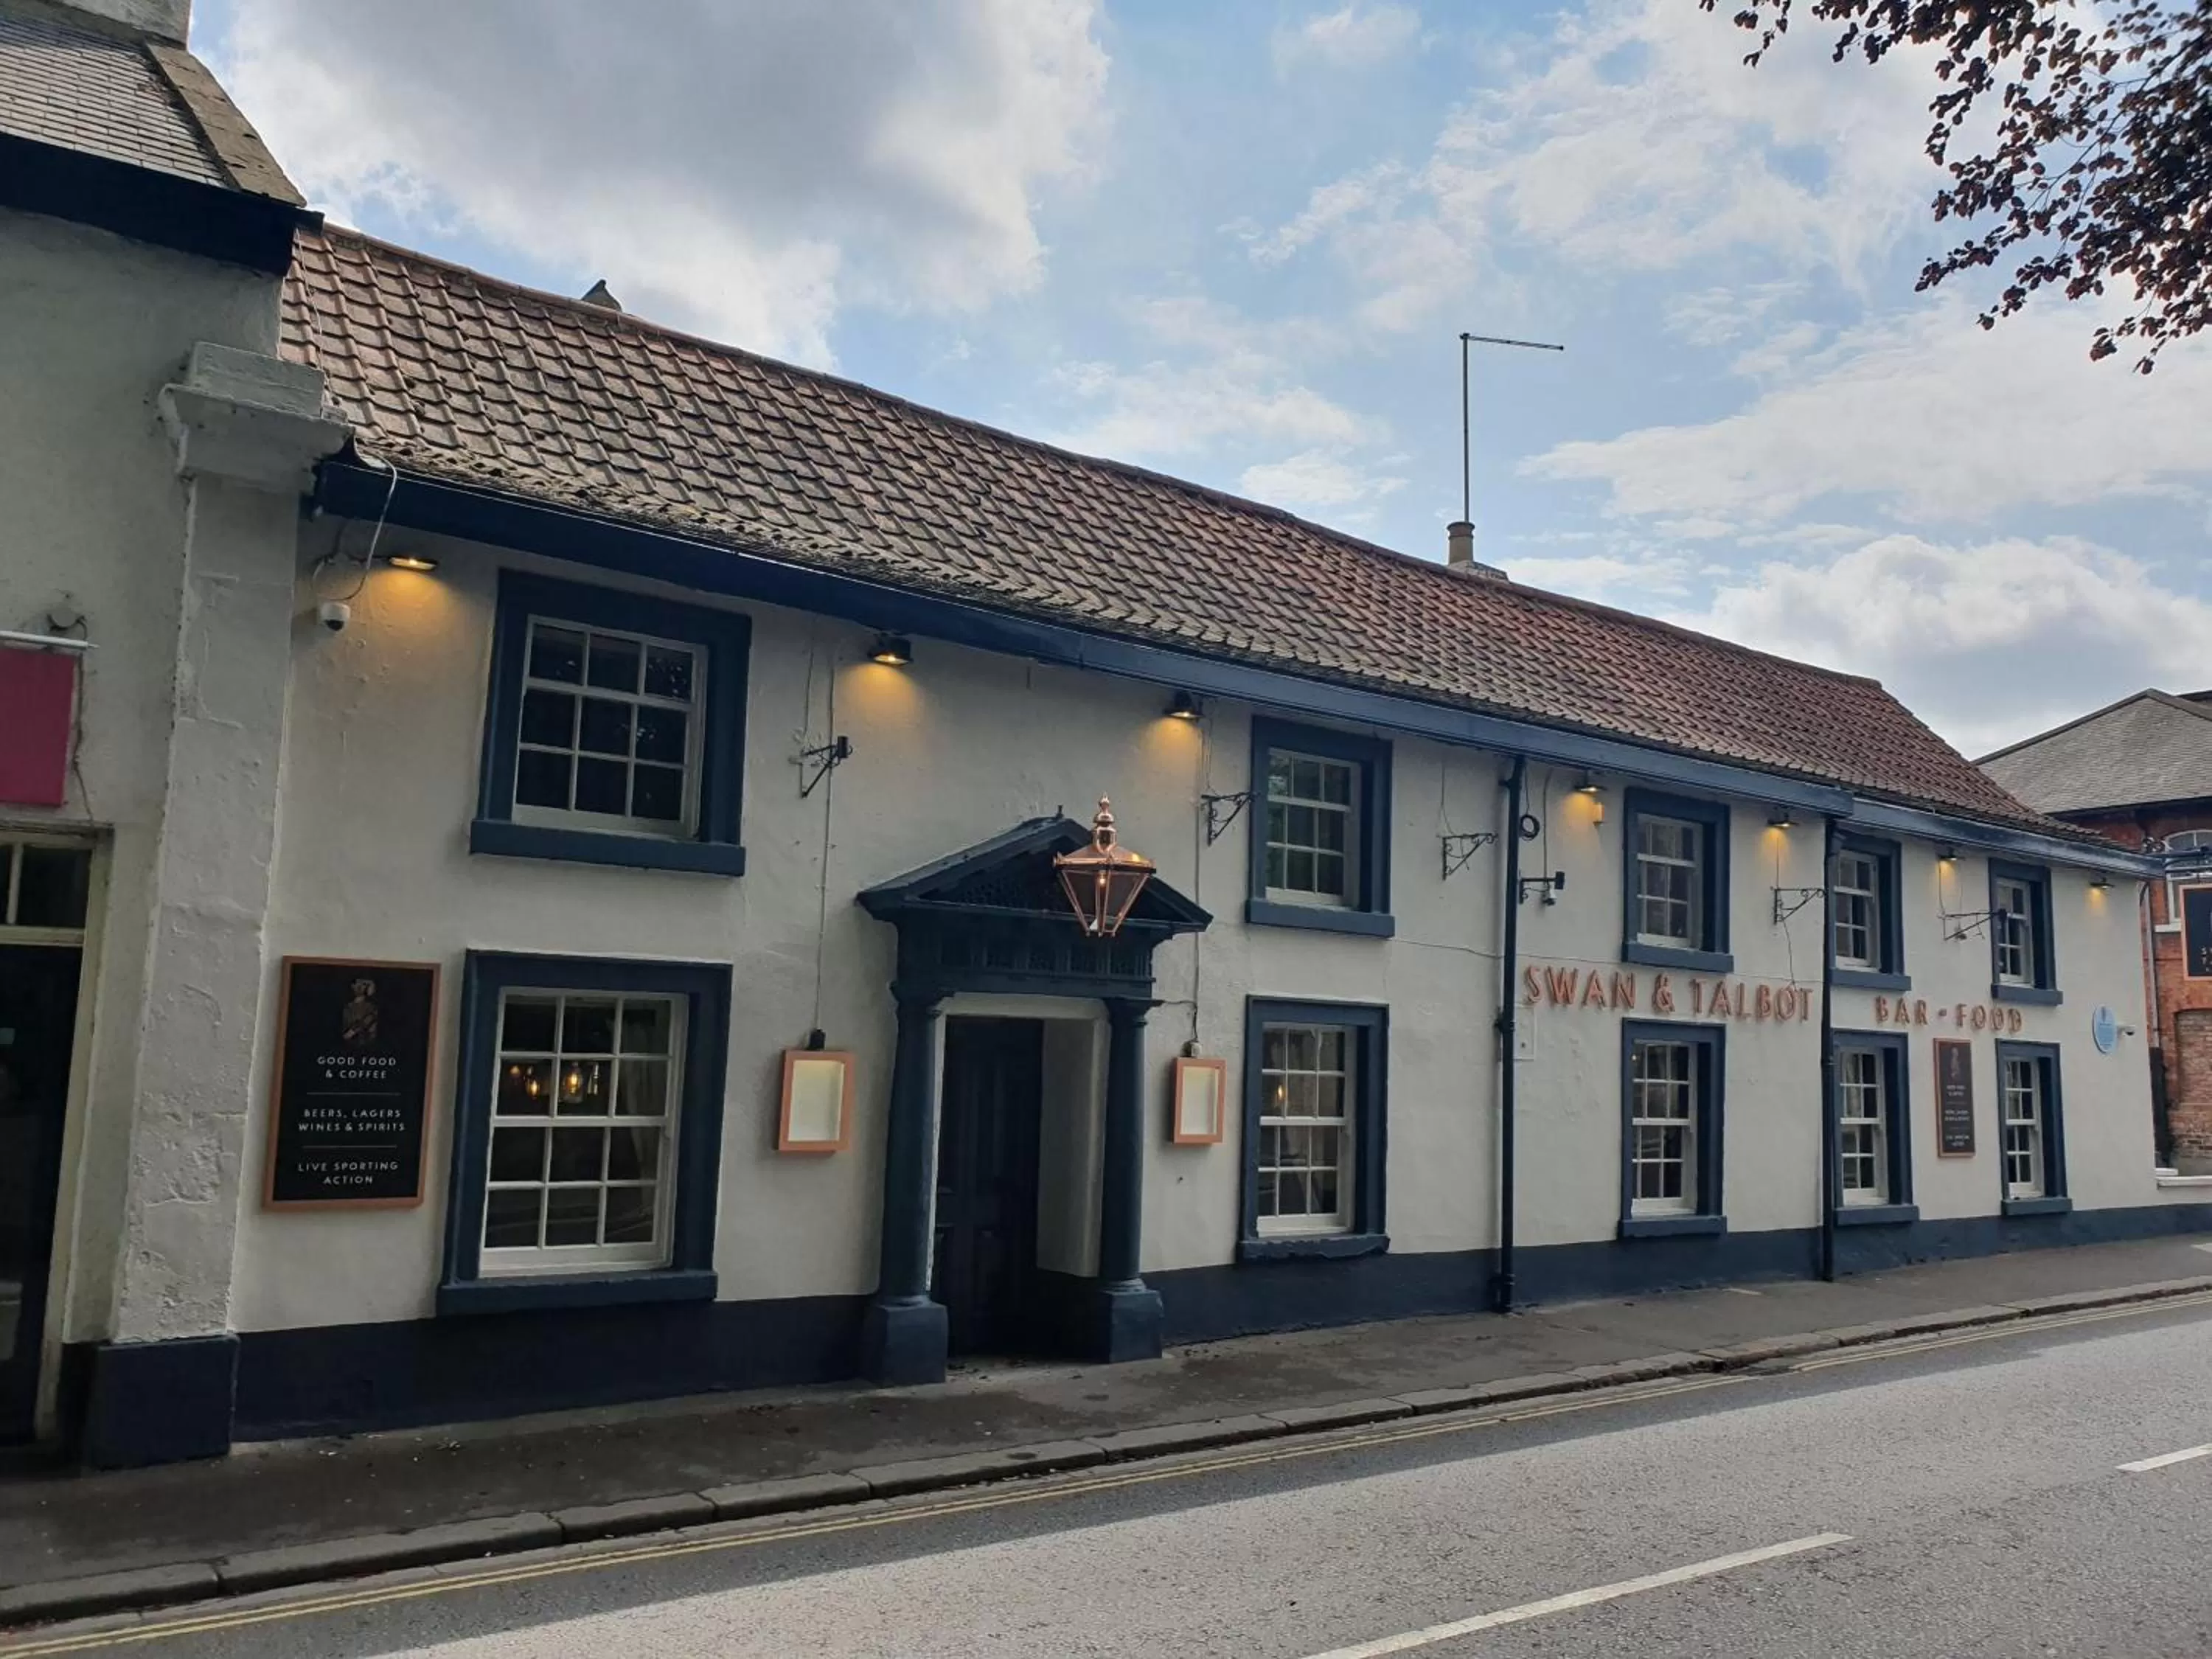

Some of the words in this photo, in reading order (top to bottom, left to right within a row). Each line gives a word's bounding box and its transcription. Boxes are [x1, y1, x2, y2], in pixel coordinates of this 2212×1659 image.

[1525, 965, 1636, 1009] SWAN
[1652, 973, 1676, 1014] &
[1688, 978, 1814, 1021] TALBOT
[1875, 996, 1928, 1026] BAR
[1956, 1003, 2023, 1032] FOOD
[317, 1056, 355, 1065] GOOD
[361, 1057, 397, 1065] FOOD
[325, 1069, 333, 1078] &
[339, 1070, 387, 1079] COFFEE
[352, 1108, 401, 1118] LAGERS
[298, 1122, 341, 1132] WINES
[344, 1122, 353, 1132] &
[358, 1122, 406, 1132] SPIRITS
[298, 1161, 327, 1172] LIVE
[334, 1161, 399, 1171] SPORTING
[322, 1175, 373, 1185] ACTION
